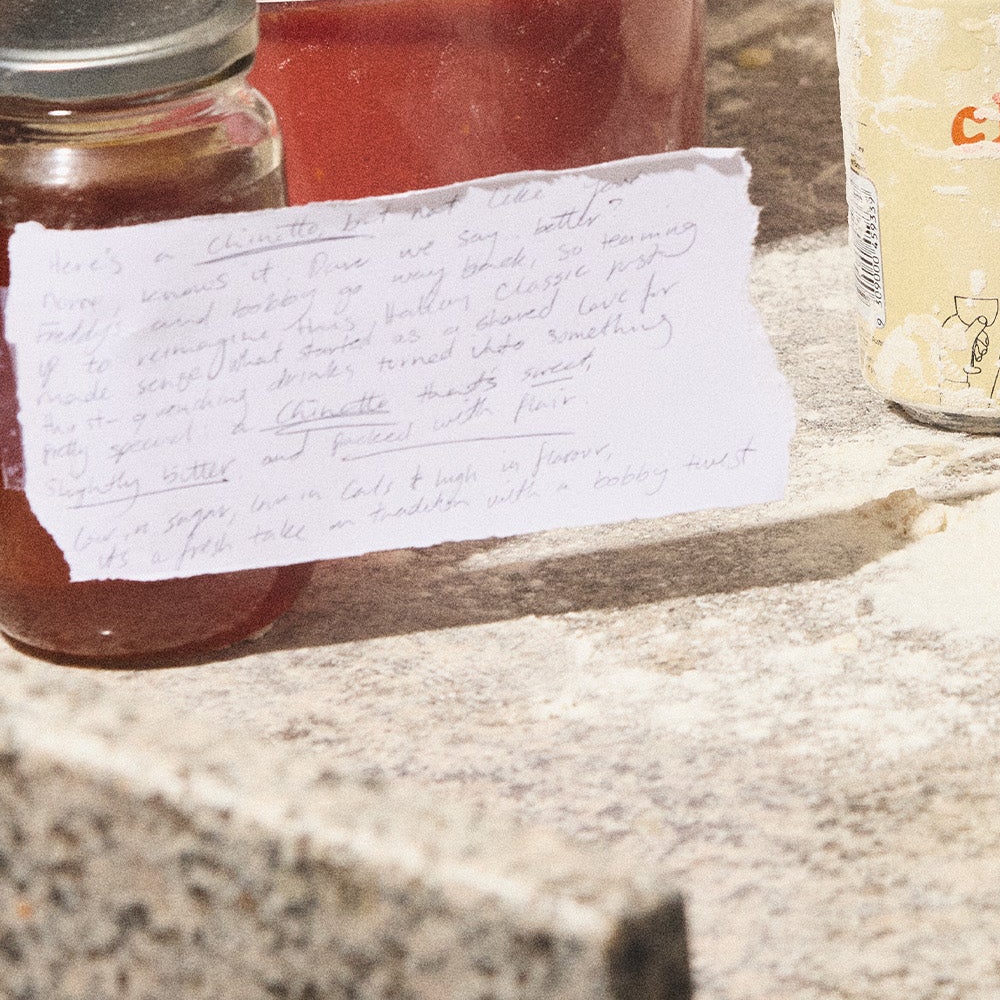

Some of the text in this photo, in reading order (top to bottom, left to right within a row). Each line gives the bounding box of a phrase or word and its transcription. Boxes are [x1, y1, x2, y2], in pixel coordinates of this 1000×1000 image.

[140, 272, 230, 304] knows
[399, 240, 436, 259] we
[150, 300, 215, 333] and
[231, 288, 317, 330] bobby
[333, 283, 364, 316] go
[391, 267, 447, 305] way
[557, 242, 584, 262] so
[153, 252, 175, 264] a
[392, 328, 422, 345] as
[443, 324, 462, 338] a
[475, 288, 561, 332] shared
[578, 290, 629, 317] love
[639, 272, 680, 316] for
[83, 357, 111, 375] to
[267, 360, 356, 393] drinks
[379, 337, 457, 371] turned
[547, 313, 674, 351] something
[262, 429, 311, 467] and
[331, 421, 415, 458] packed
[432, 396, 495, 433] with
[176, 532, 234, 573] fresh
[247, 518, 307, 543] take
[369, 494, 471, 523] tradition
[486, 477, 541, 510] with
[556, 482, 570, 493] a
[592, 461, 670, 498] bobby
[681, 435, 757, 473] twist
[300, 488, 322, 502] in
[434, 463, 478, 506] high
[501, 448, 520, 473] in
